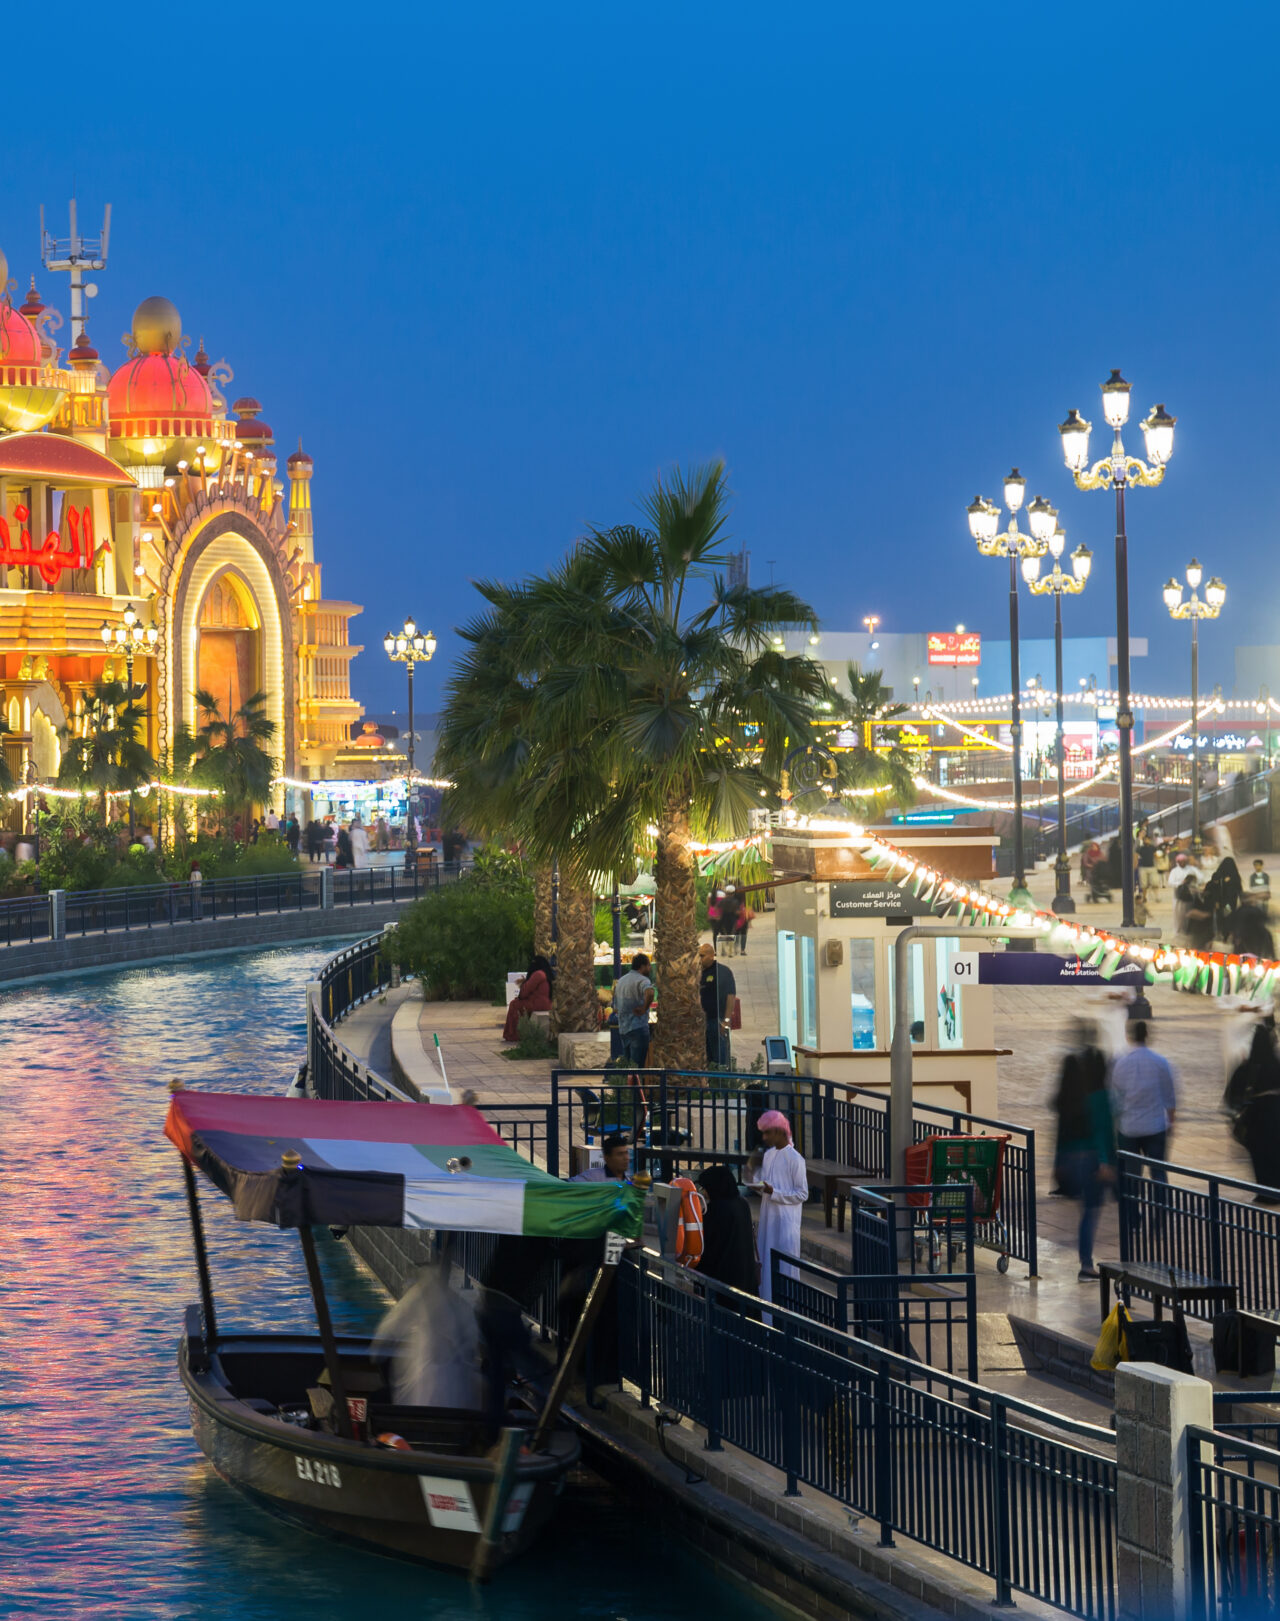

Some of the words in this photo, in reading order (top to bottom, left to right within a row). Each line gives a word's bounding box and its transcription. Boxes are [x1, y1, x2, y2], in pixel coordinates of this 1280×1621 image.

[862, 891, 885, 899] العملاء
[886, 892, 901, 900] مركز
[835, 900, 872, 908] Customer
[873, 900, 901, 908] Service
[954, 962, 972, 975] 01
[295, 1455, 316, 1482] EA
[313, 1460, 342, 1489] 218
